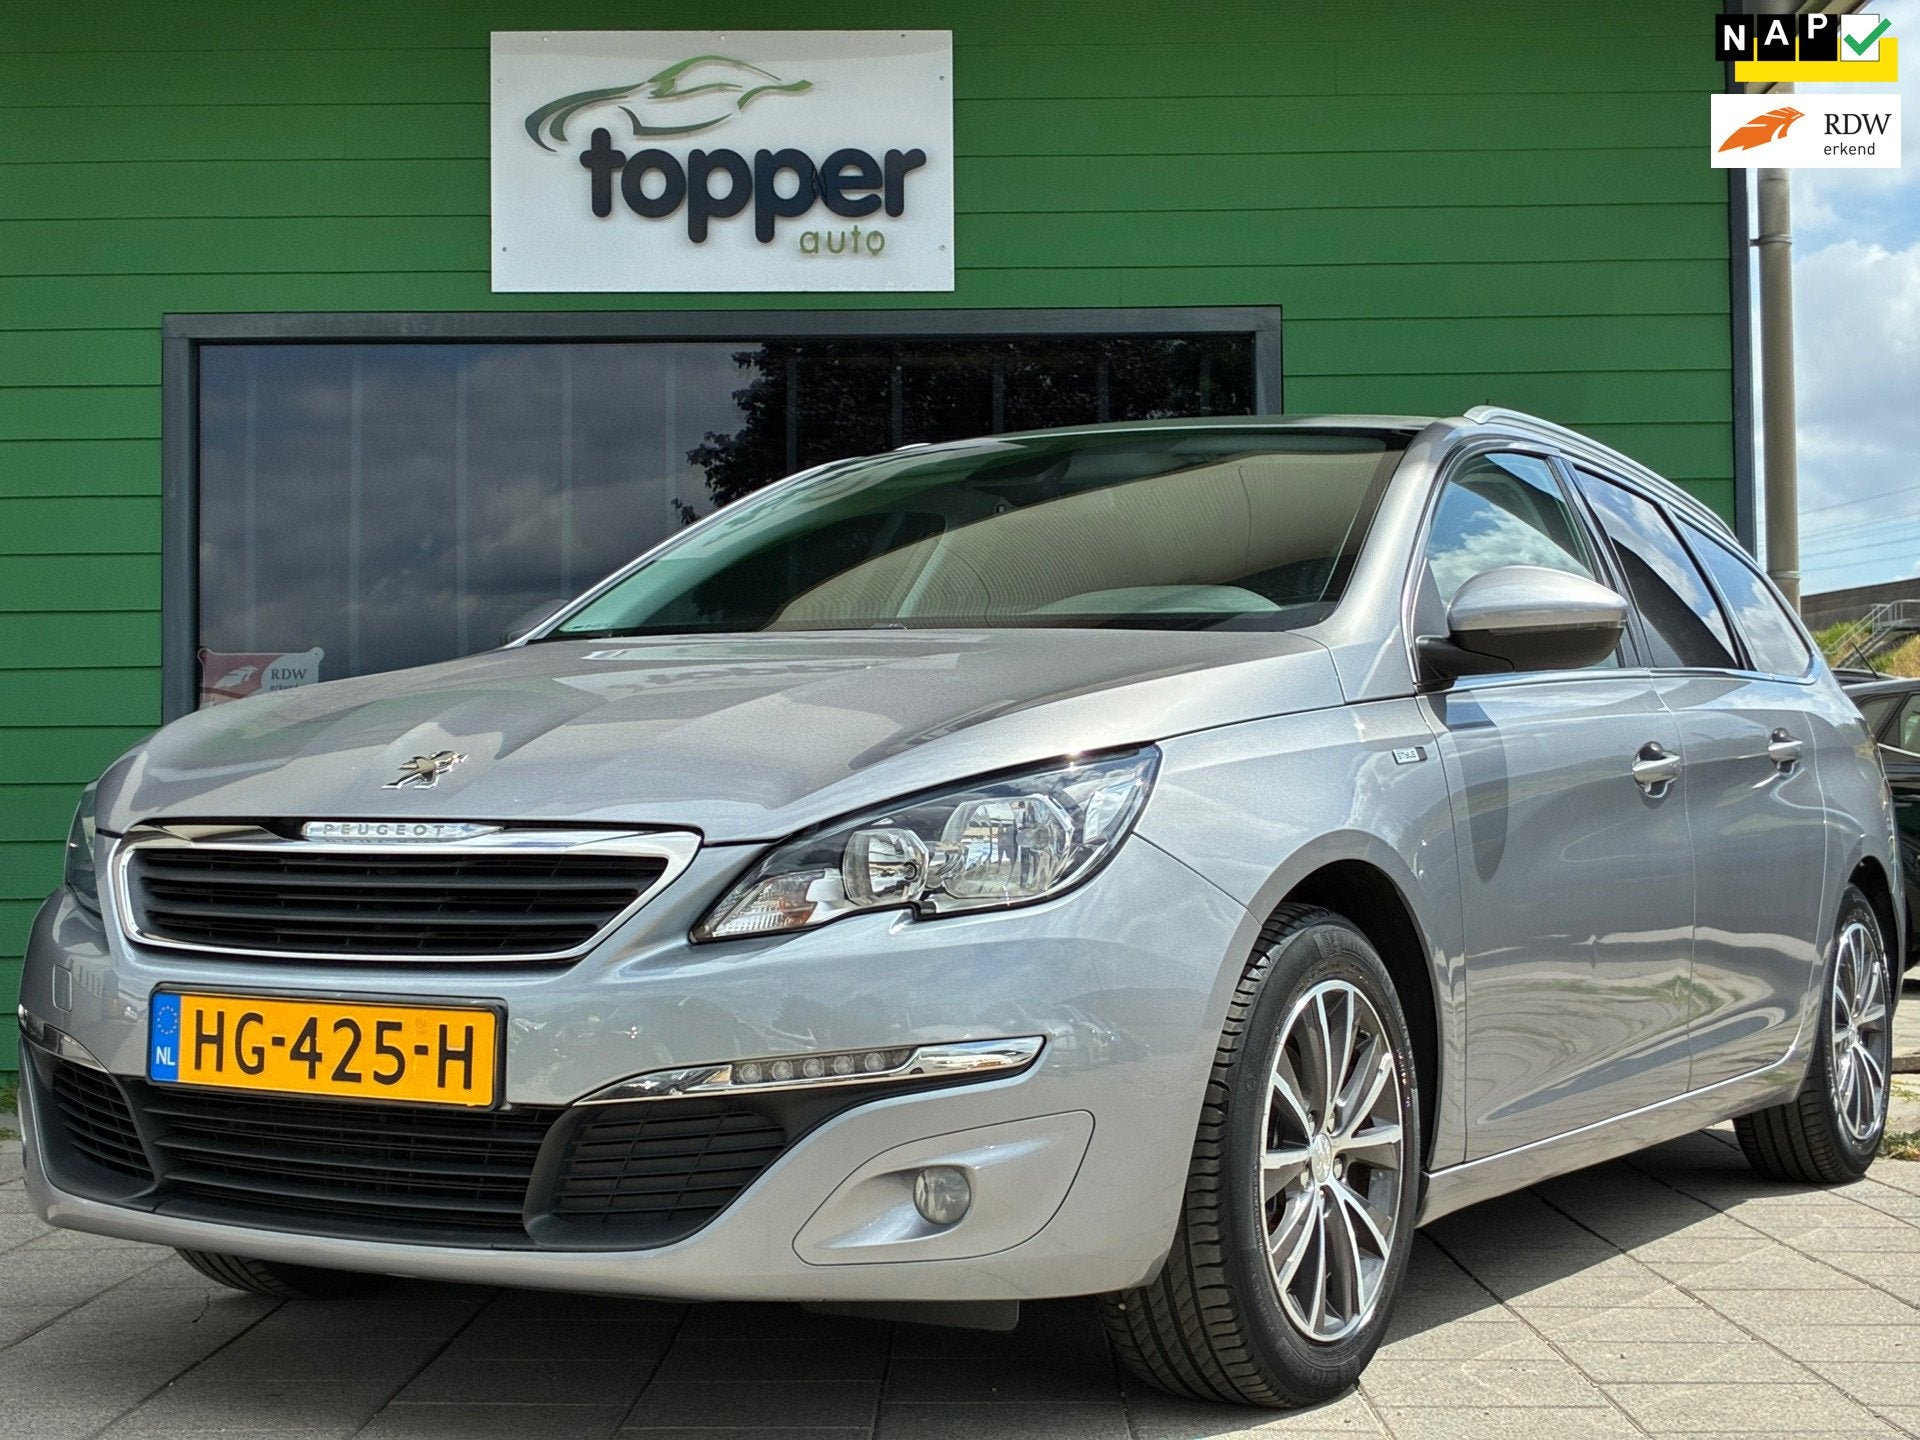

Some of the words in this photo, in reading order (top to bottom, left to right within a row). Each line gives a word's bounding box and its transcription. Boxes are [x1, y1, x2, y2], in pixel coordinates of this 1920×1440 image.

[579, 127, 927, 244] topper
[799, 225, 886, 255] auto
[270, 668, 308, 680] RDW
[322, 824, 446, 836] PEUGEOT
[155, 1046, 176, 1066] NL
[194, 1009, 474, 1090] HG-425-H
